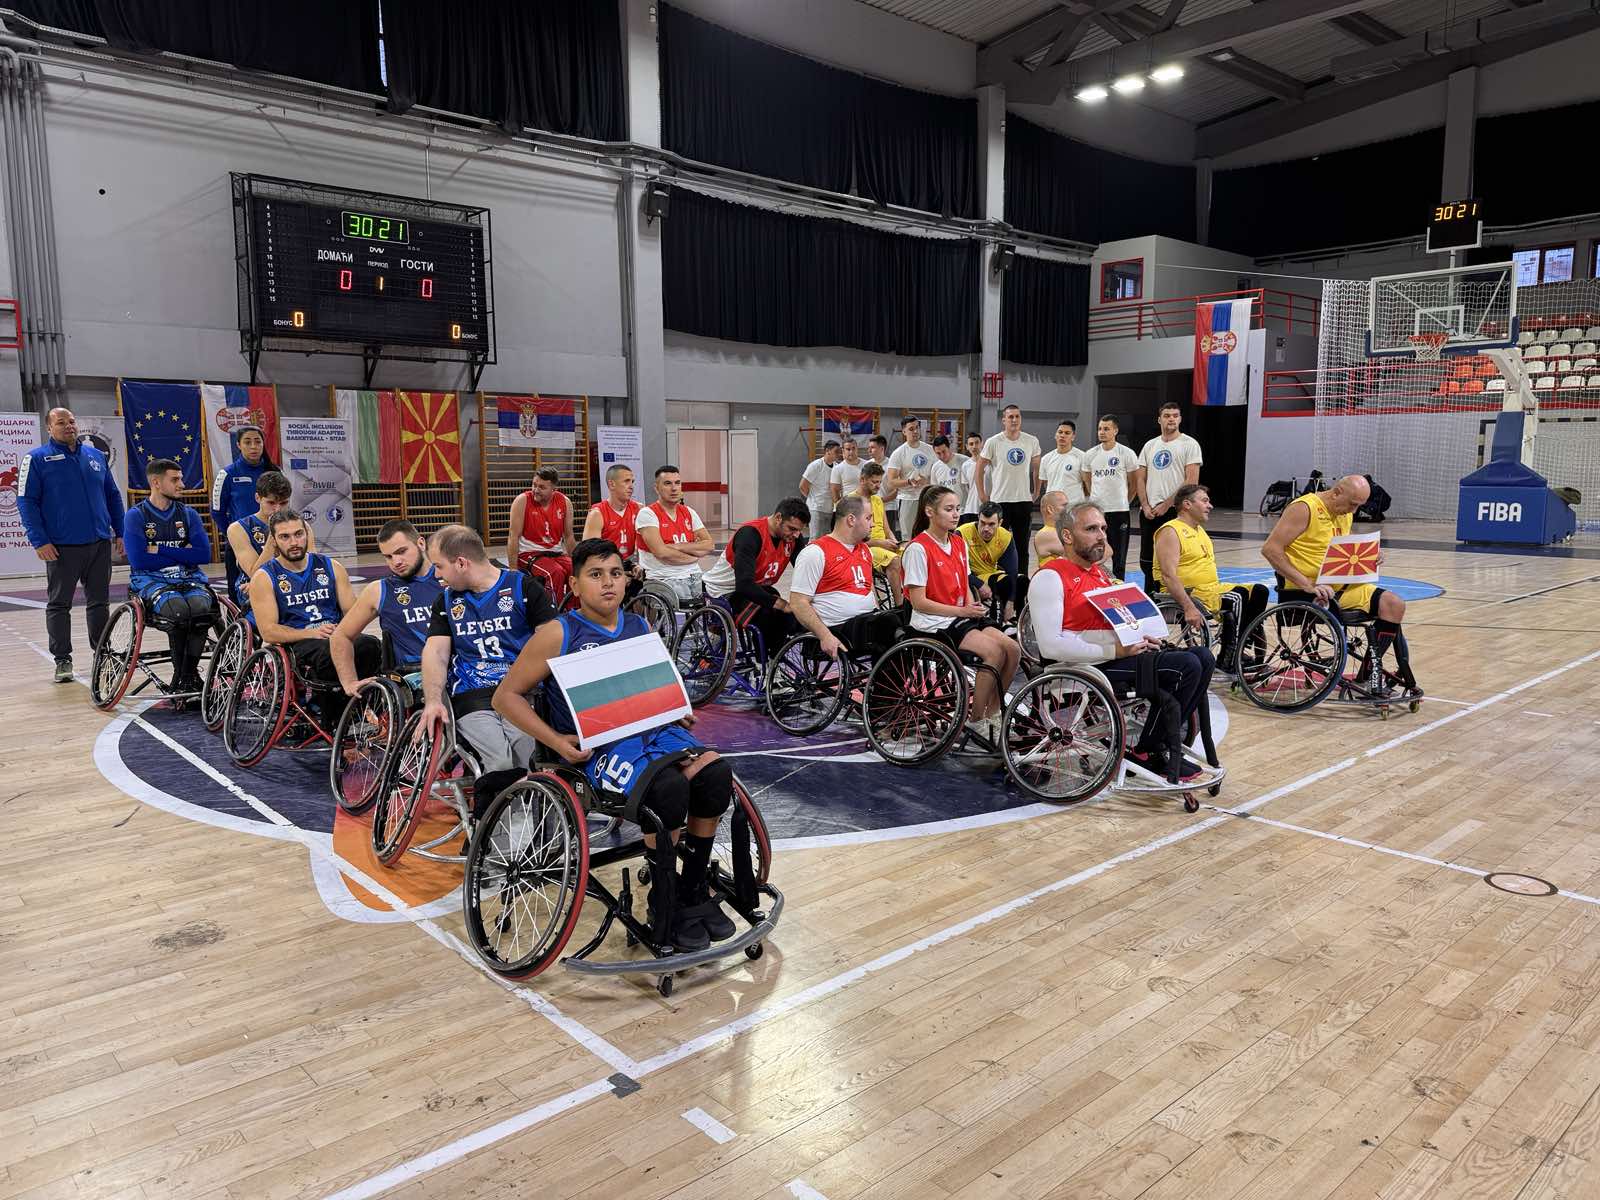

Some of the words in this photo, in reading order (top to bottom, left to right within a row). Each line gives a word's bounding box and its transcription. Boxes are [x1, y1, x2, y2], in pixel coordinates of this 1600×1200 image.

[1434, 206, 1453, 221] 30
[1456, 203, 1477, 218] 21
[349, 215, 373, 237] 30
[379, 219, 403, 241] 21
[317, 249, 353, 263] ДОМАЋИ
[400, 259, 434, 272] ГОСТИ
[340, 270, 352, 290] 0
[422, 278, 433, 298] 0
[294, 311, 304, 328] 0
[452, 324, 461, 339] 0
[1477, 502, 1522, 522] FIBA
[851, 565, 866, 584] 14
[286, 588, 330, 606] LEVSKI
[305, 604, 322, 622] 3
[455, 616, 512, 636] LEVSKI
[473, 636, 505, 659] 13
